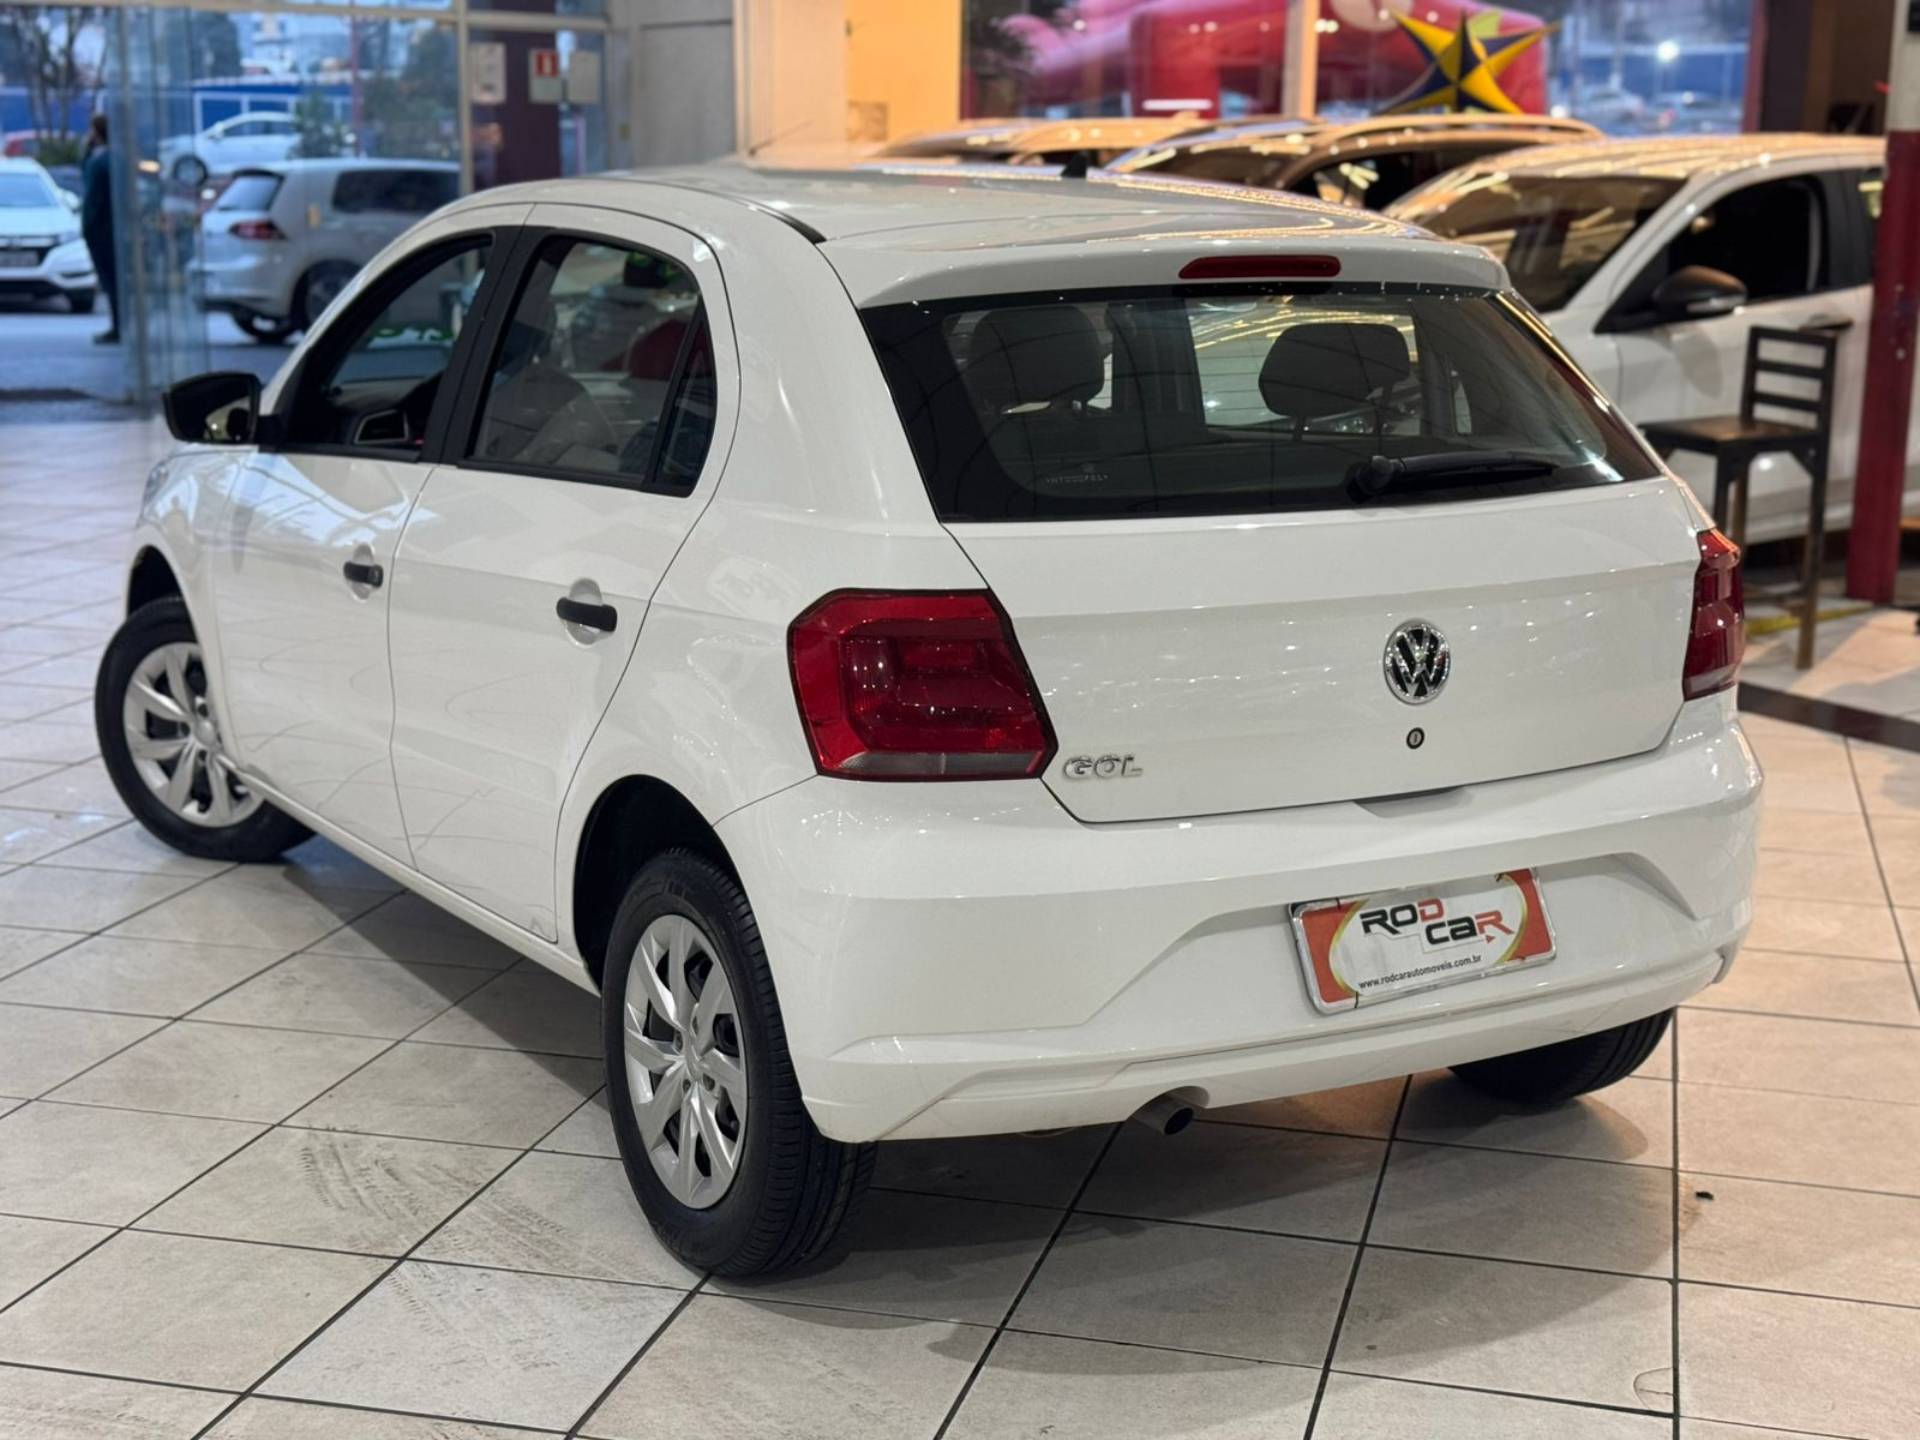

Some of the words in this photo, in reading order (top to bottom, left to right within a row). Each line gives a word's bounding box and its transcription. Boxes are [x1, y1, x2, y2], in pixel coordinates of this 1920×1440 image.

[1063, 754, 1144, 780] GOL
[1359, 897, 1445, 935] ROD
[1358, 954, 1482, 989] www.rodcarautomoveis.com.br
